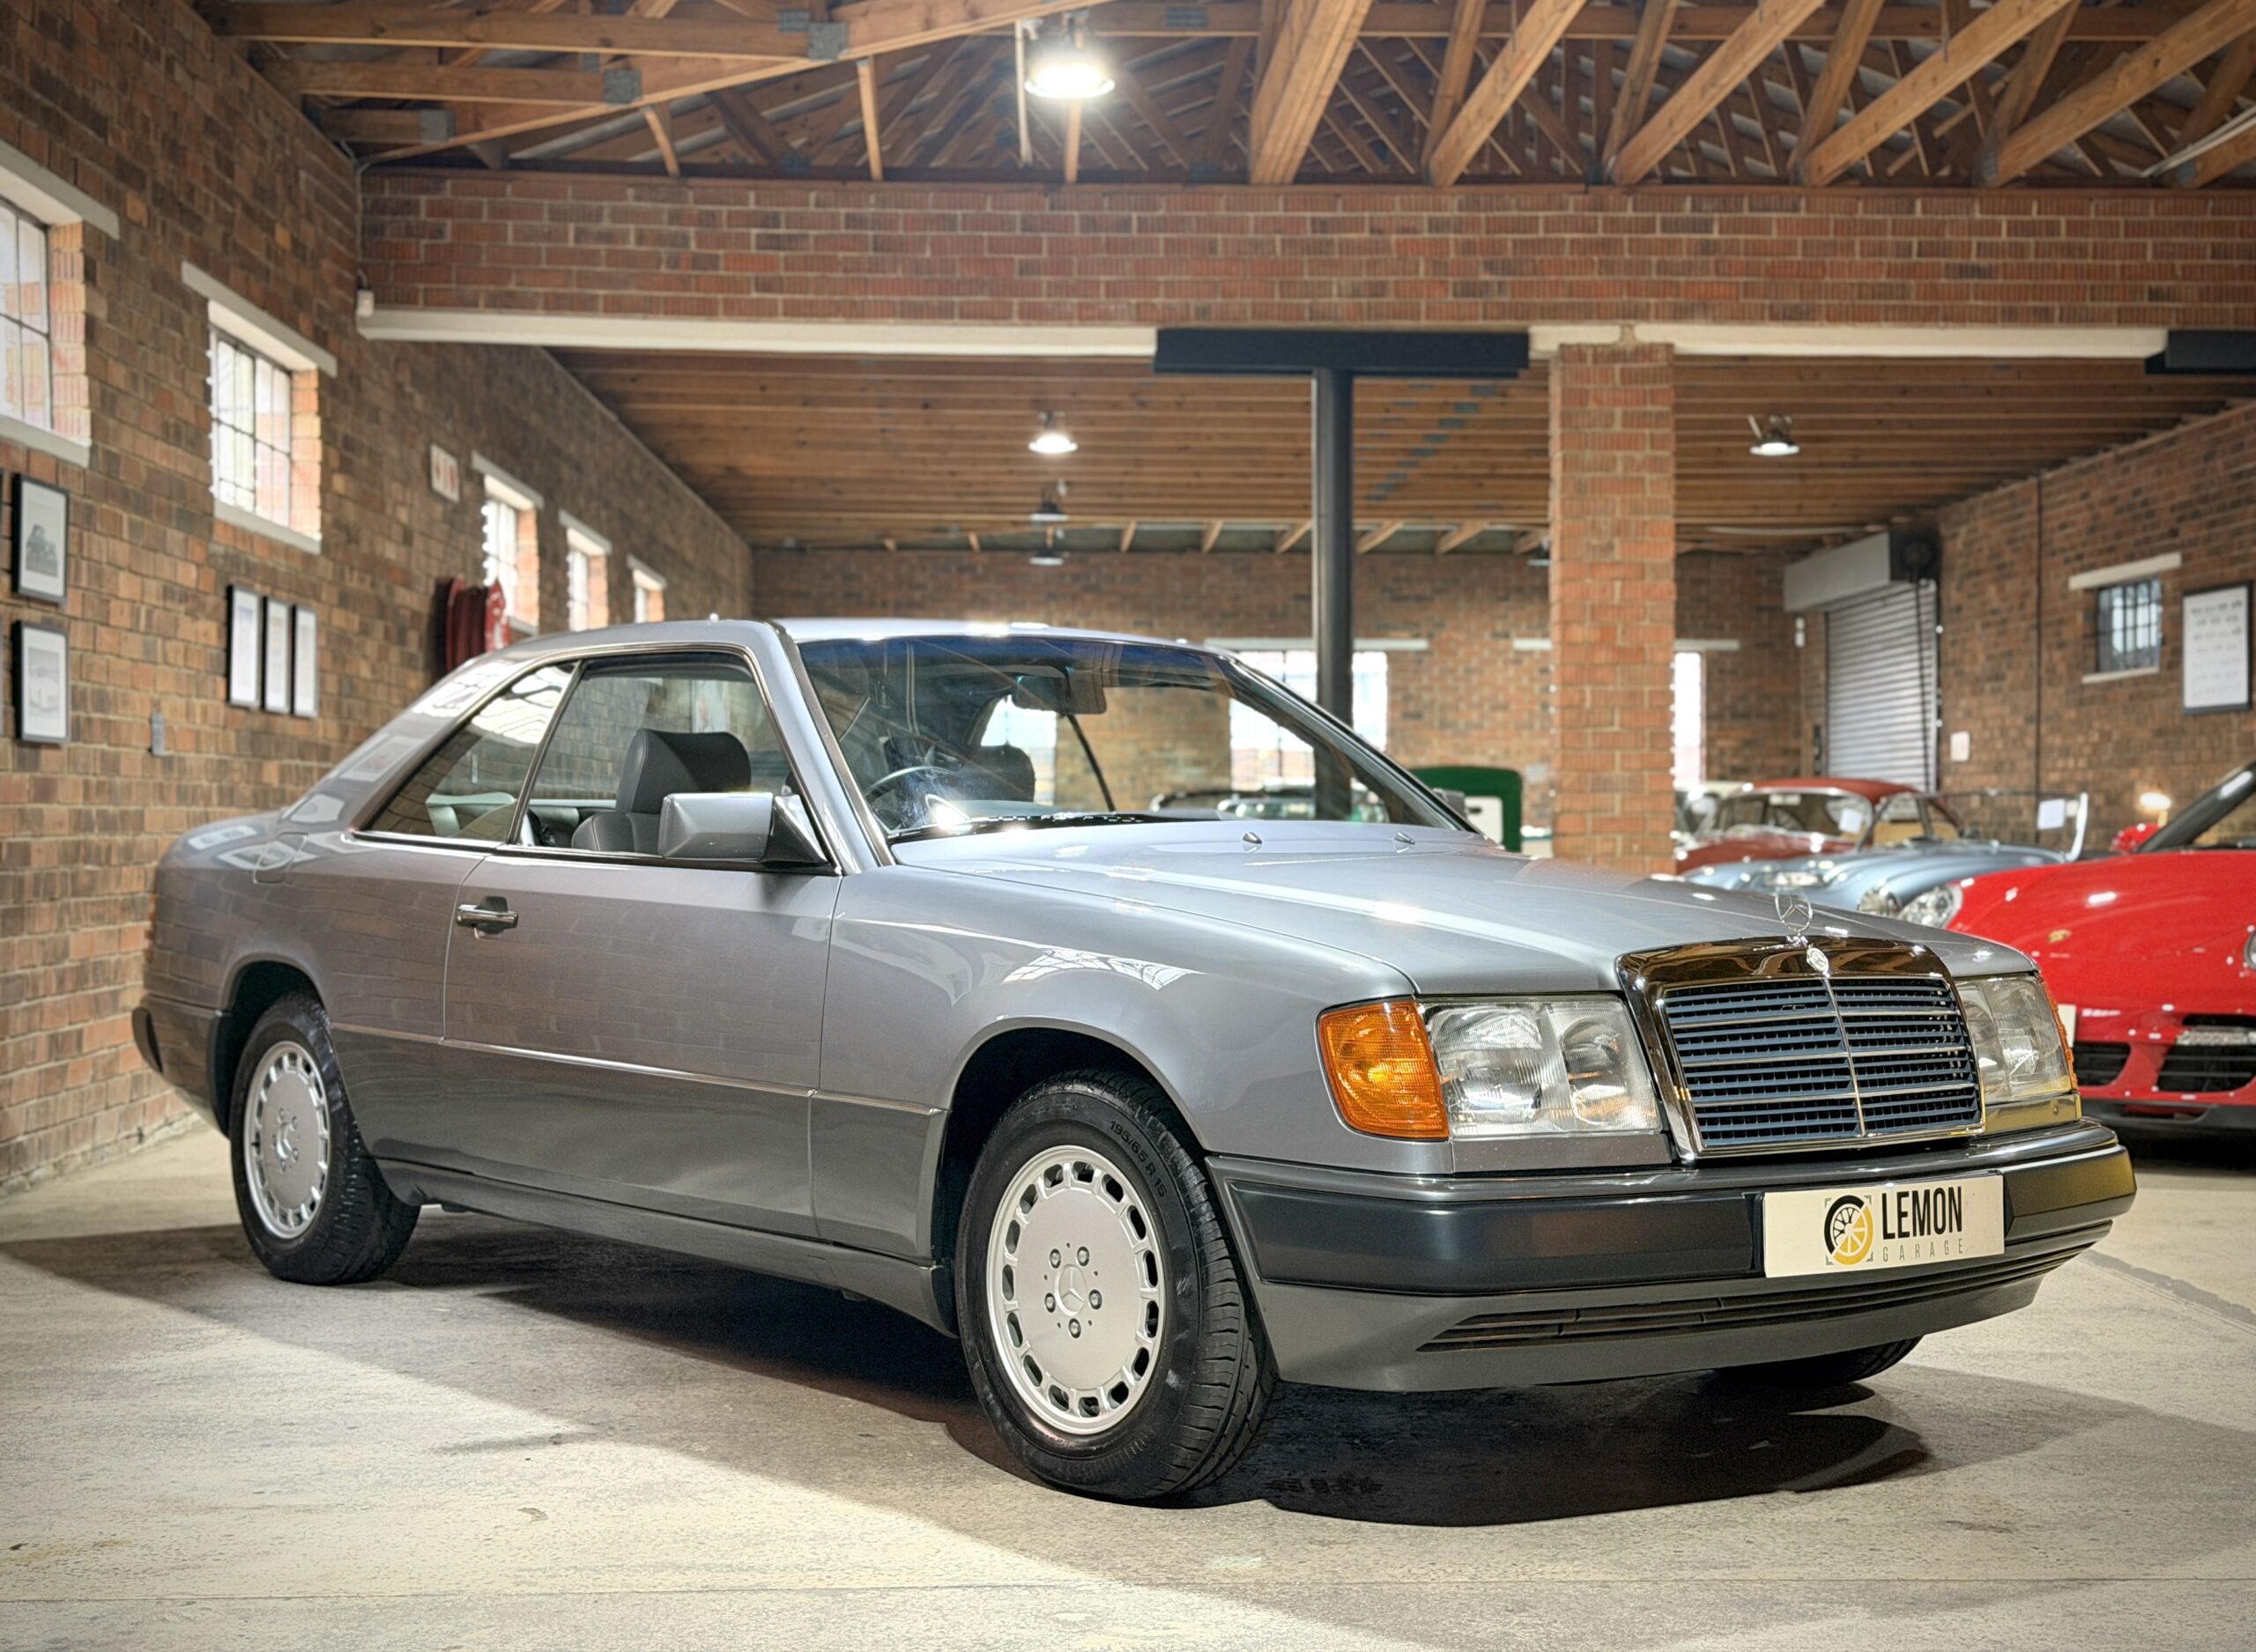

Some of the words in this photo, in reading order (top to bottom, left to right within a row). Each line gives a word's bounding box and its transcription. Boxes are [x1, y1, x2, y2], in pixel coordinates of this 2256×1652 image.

[1110, 1121, 1148, 1162] 195/65
[1146, 1163, 1156, 1176] R
[1154, 1177, 1167, 1197] 15
[1881, 1186, 1963, 1240] LEMON
[1882, 1238, 1963, 1263] GARAGE
